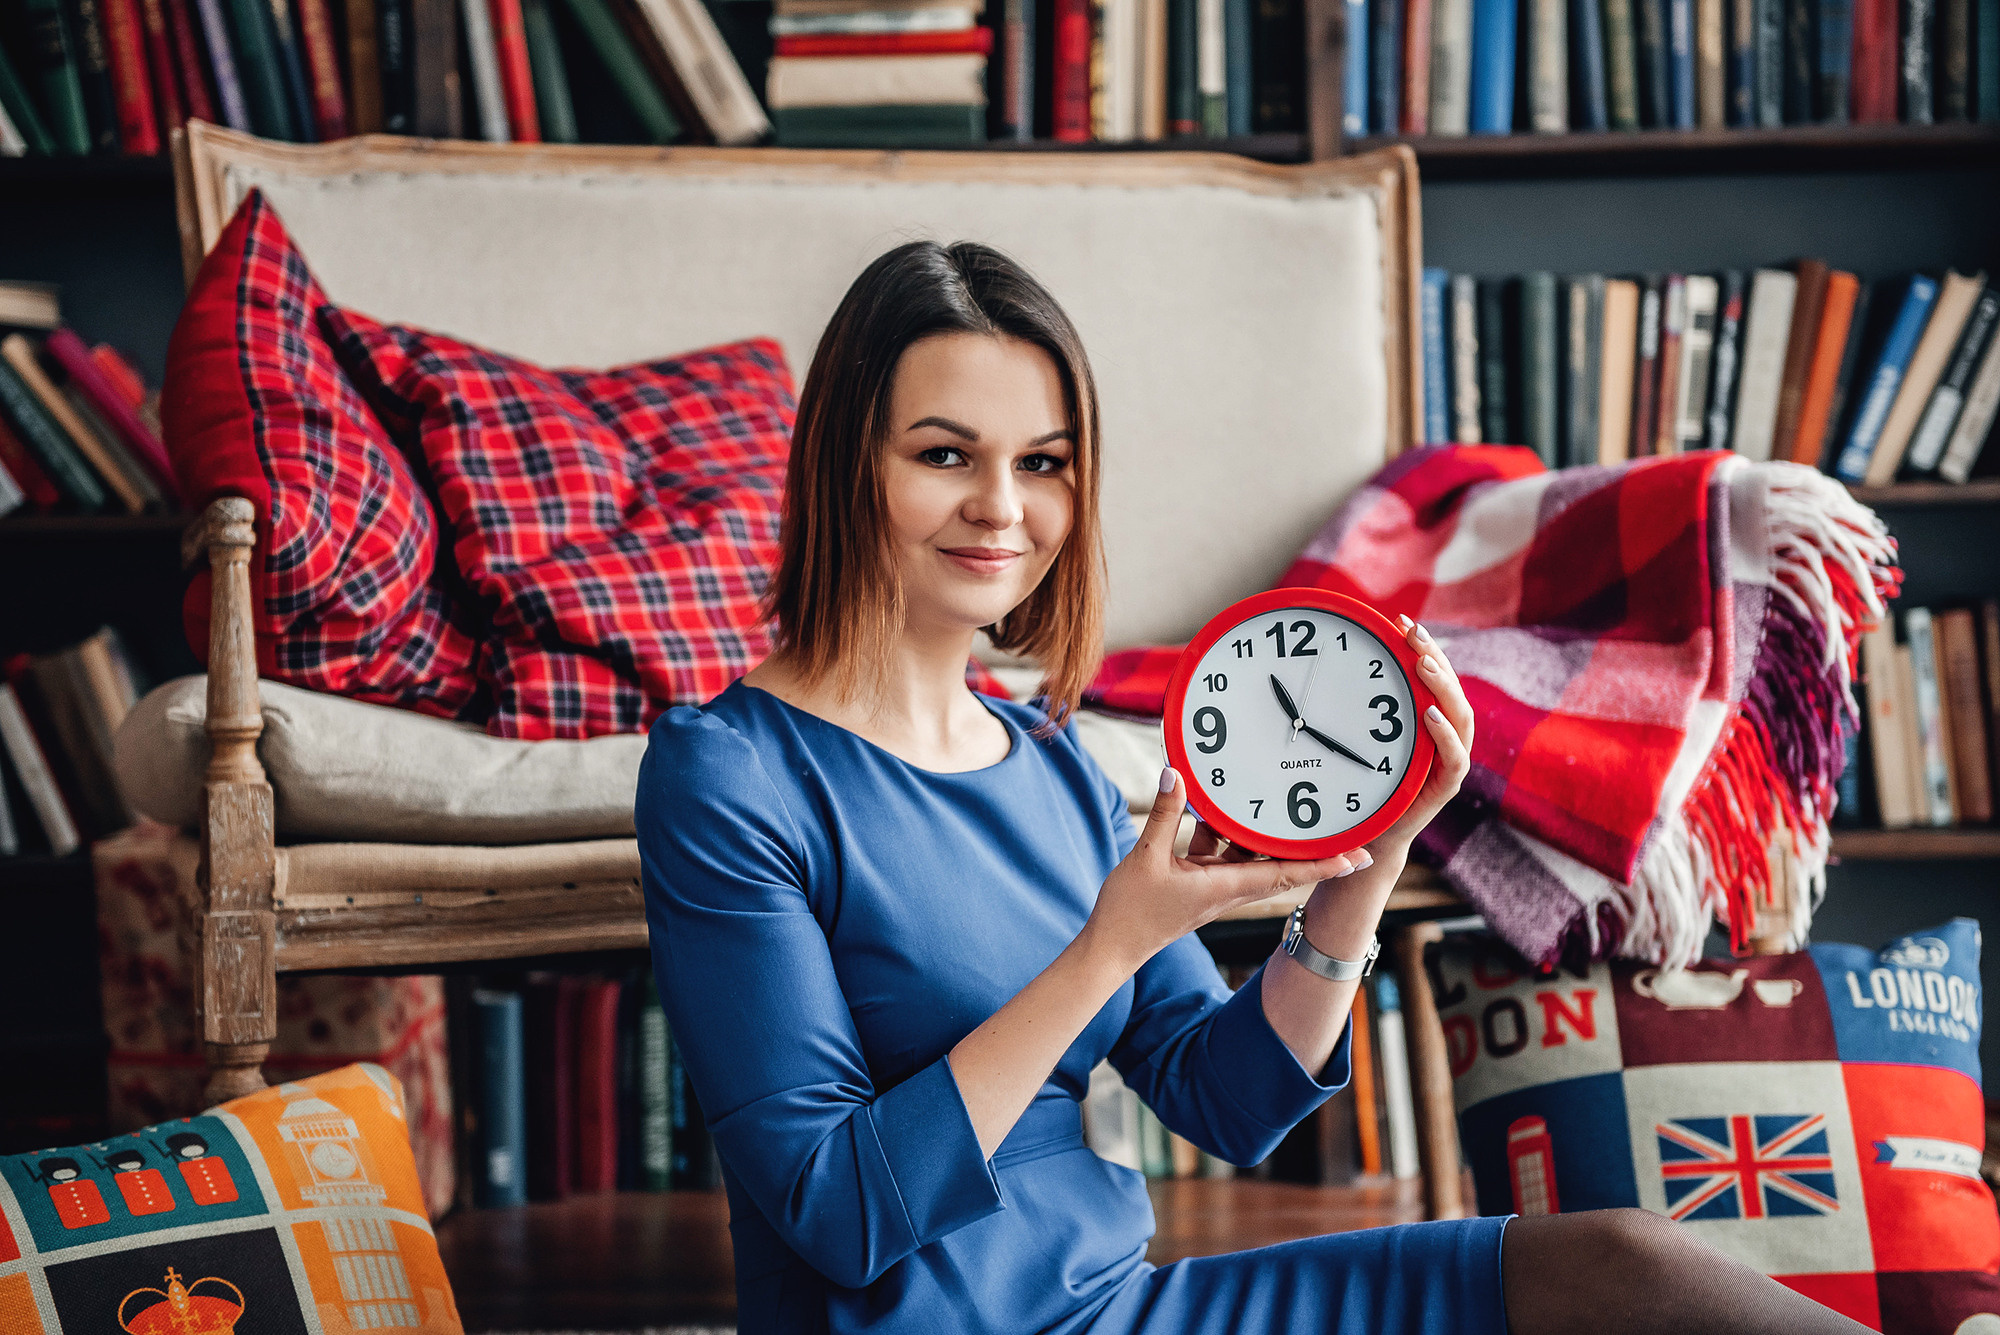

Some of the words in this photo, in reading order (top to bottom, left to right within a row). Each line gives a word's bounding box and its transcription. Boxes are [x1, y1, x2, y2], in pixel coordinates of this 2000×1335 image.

[1231, 638, 1254, 659] 11
[1265, 619, 1319, 659] 12
[1336, 631, 1348, 652] 1
[1368, 659, 1385, 680] 2
[1202, 672, 1229, 693] 10
[1367, 693, 1404, 744] 3
[1192, 705, 1228, 755] 9
[1280, 758, 1322, 770] QUARTZ
[1376, 756, 1393, 776] 4
[1211, 767, 1226, 787] 8
[1249, 799, 1265, 820] 7
[1286, 780, 1322, 830] 6
[1345, 792, 1361, 813] 5
[1846, 966, 1979, 1032] LONDON
